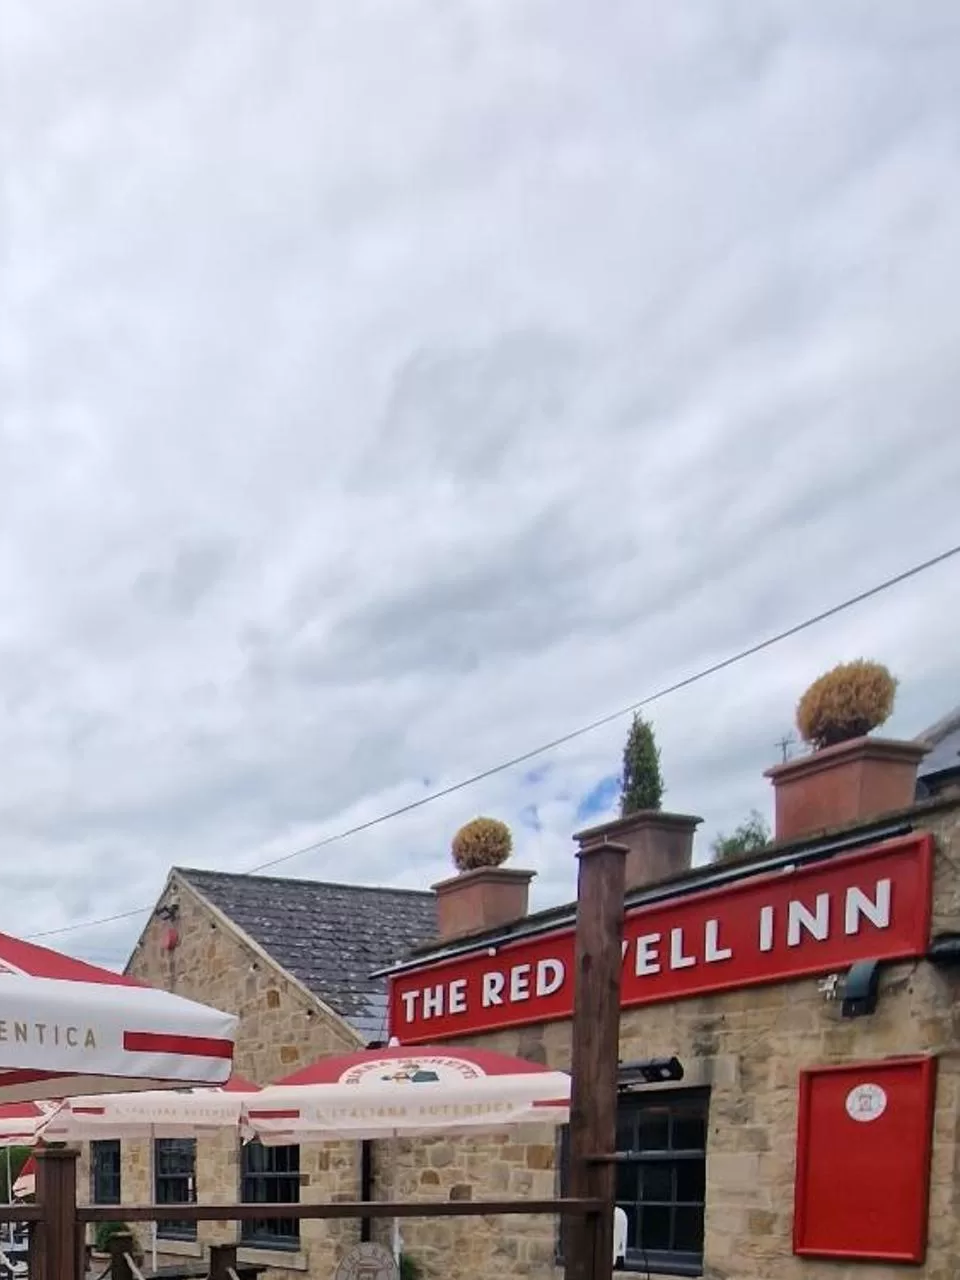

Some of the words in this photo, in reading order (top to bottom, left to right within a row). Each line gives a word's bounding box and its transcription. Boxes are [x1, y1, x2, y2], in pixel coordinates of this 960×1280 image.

[401, 979, 468, 1023] THE
[482, 958, 565, 1008] RED
[621, 919, 732, 976] ELL
[759, 878, 892, 951] INN
